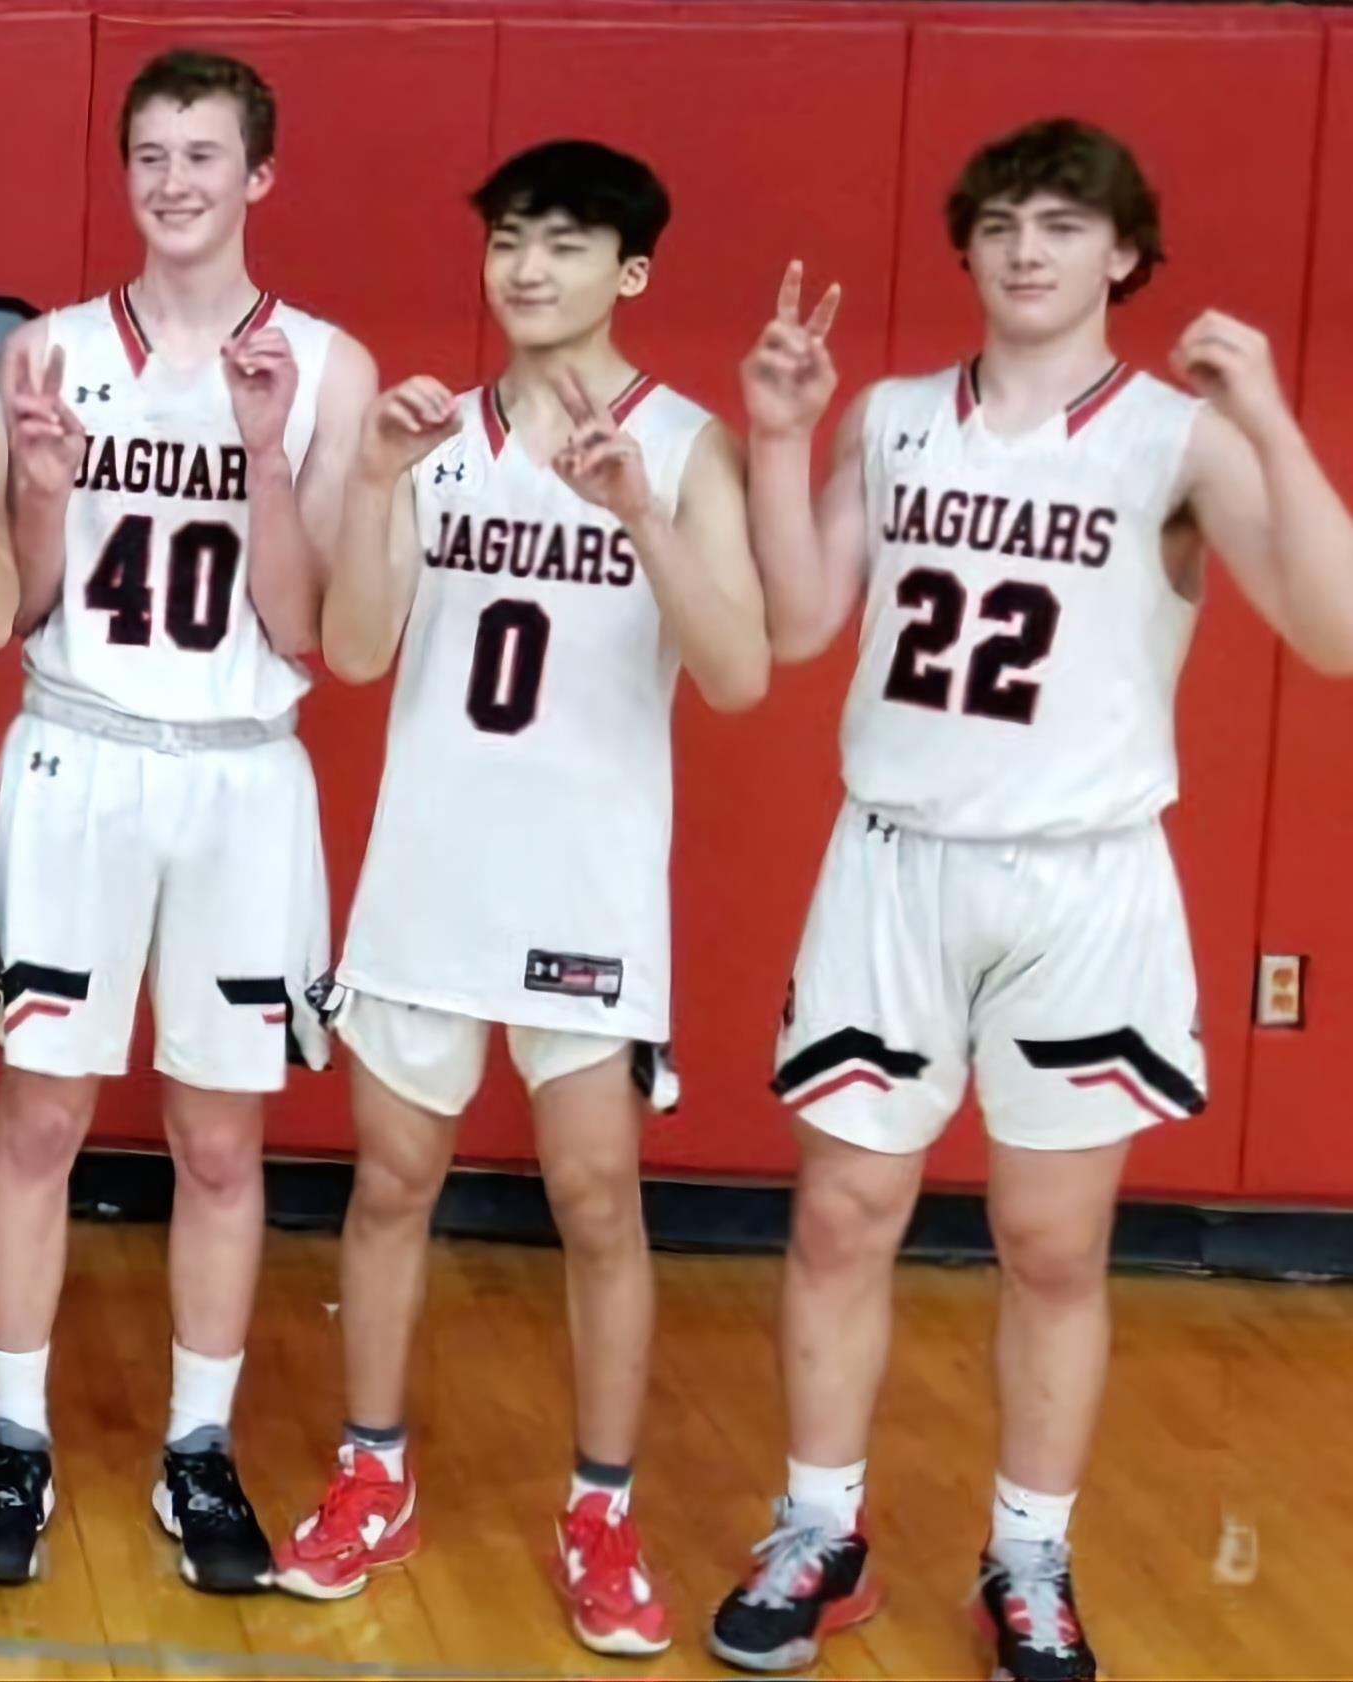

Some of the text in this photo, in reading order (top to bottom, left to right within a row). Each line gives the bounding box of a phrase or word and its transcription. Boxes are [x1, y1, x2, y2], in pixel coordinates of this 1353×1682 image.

[73, 434, 248, 501] JAGUAR
[425, 511, 635, 587] JAGUARS
[882, 483, 1117, 568] JAGUARS
[84, 513, 241, 653] 40
[465, 597, 550, 737] 0
[882, 565, 1062, 725] 22
